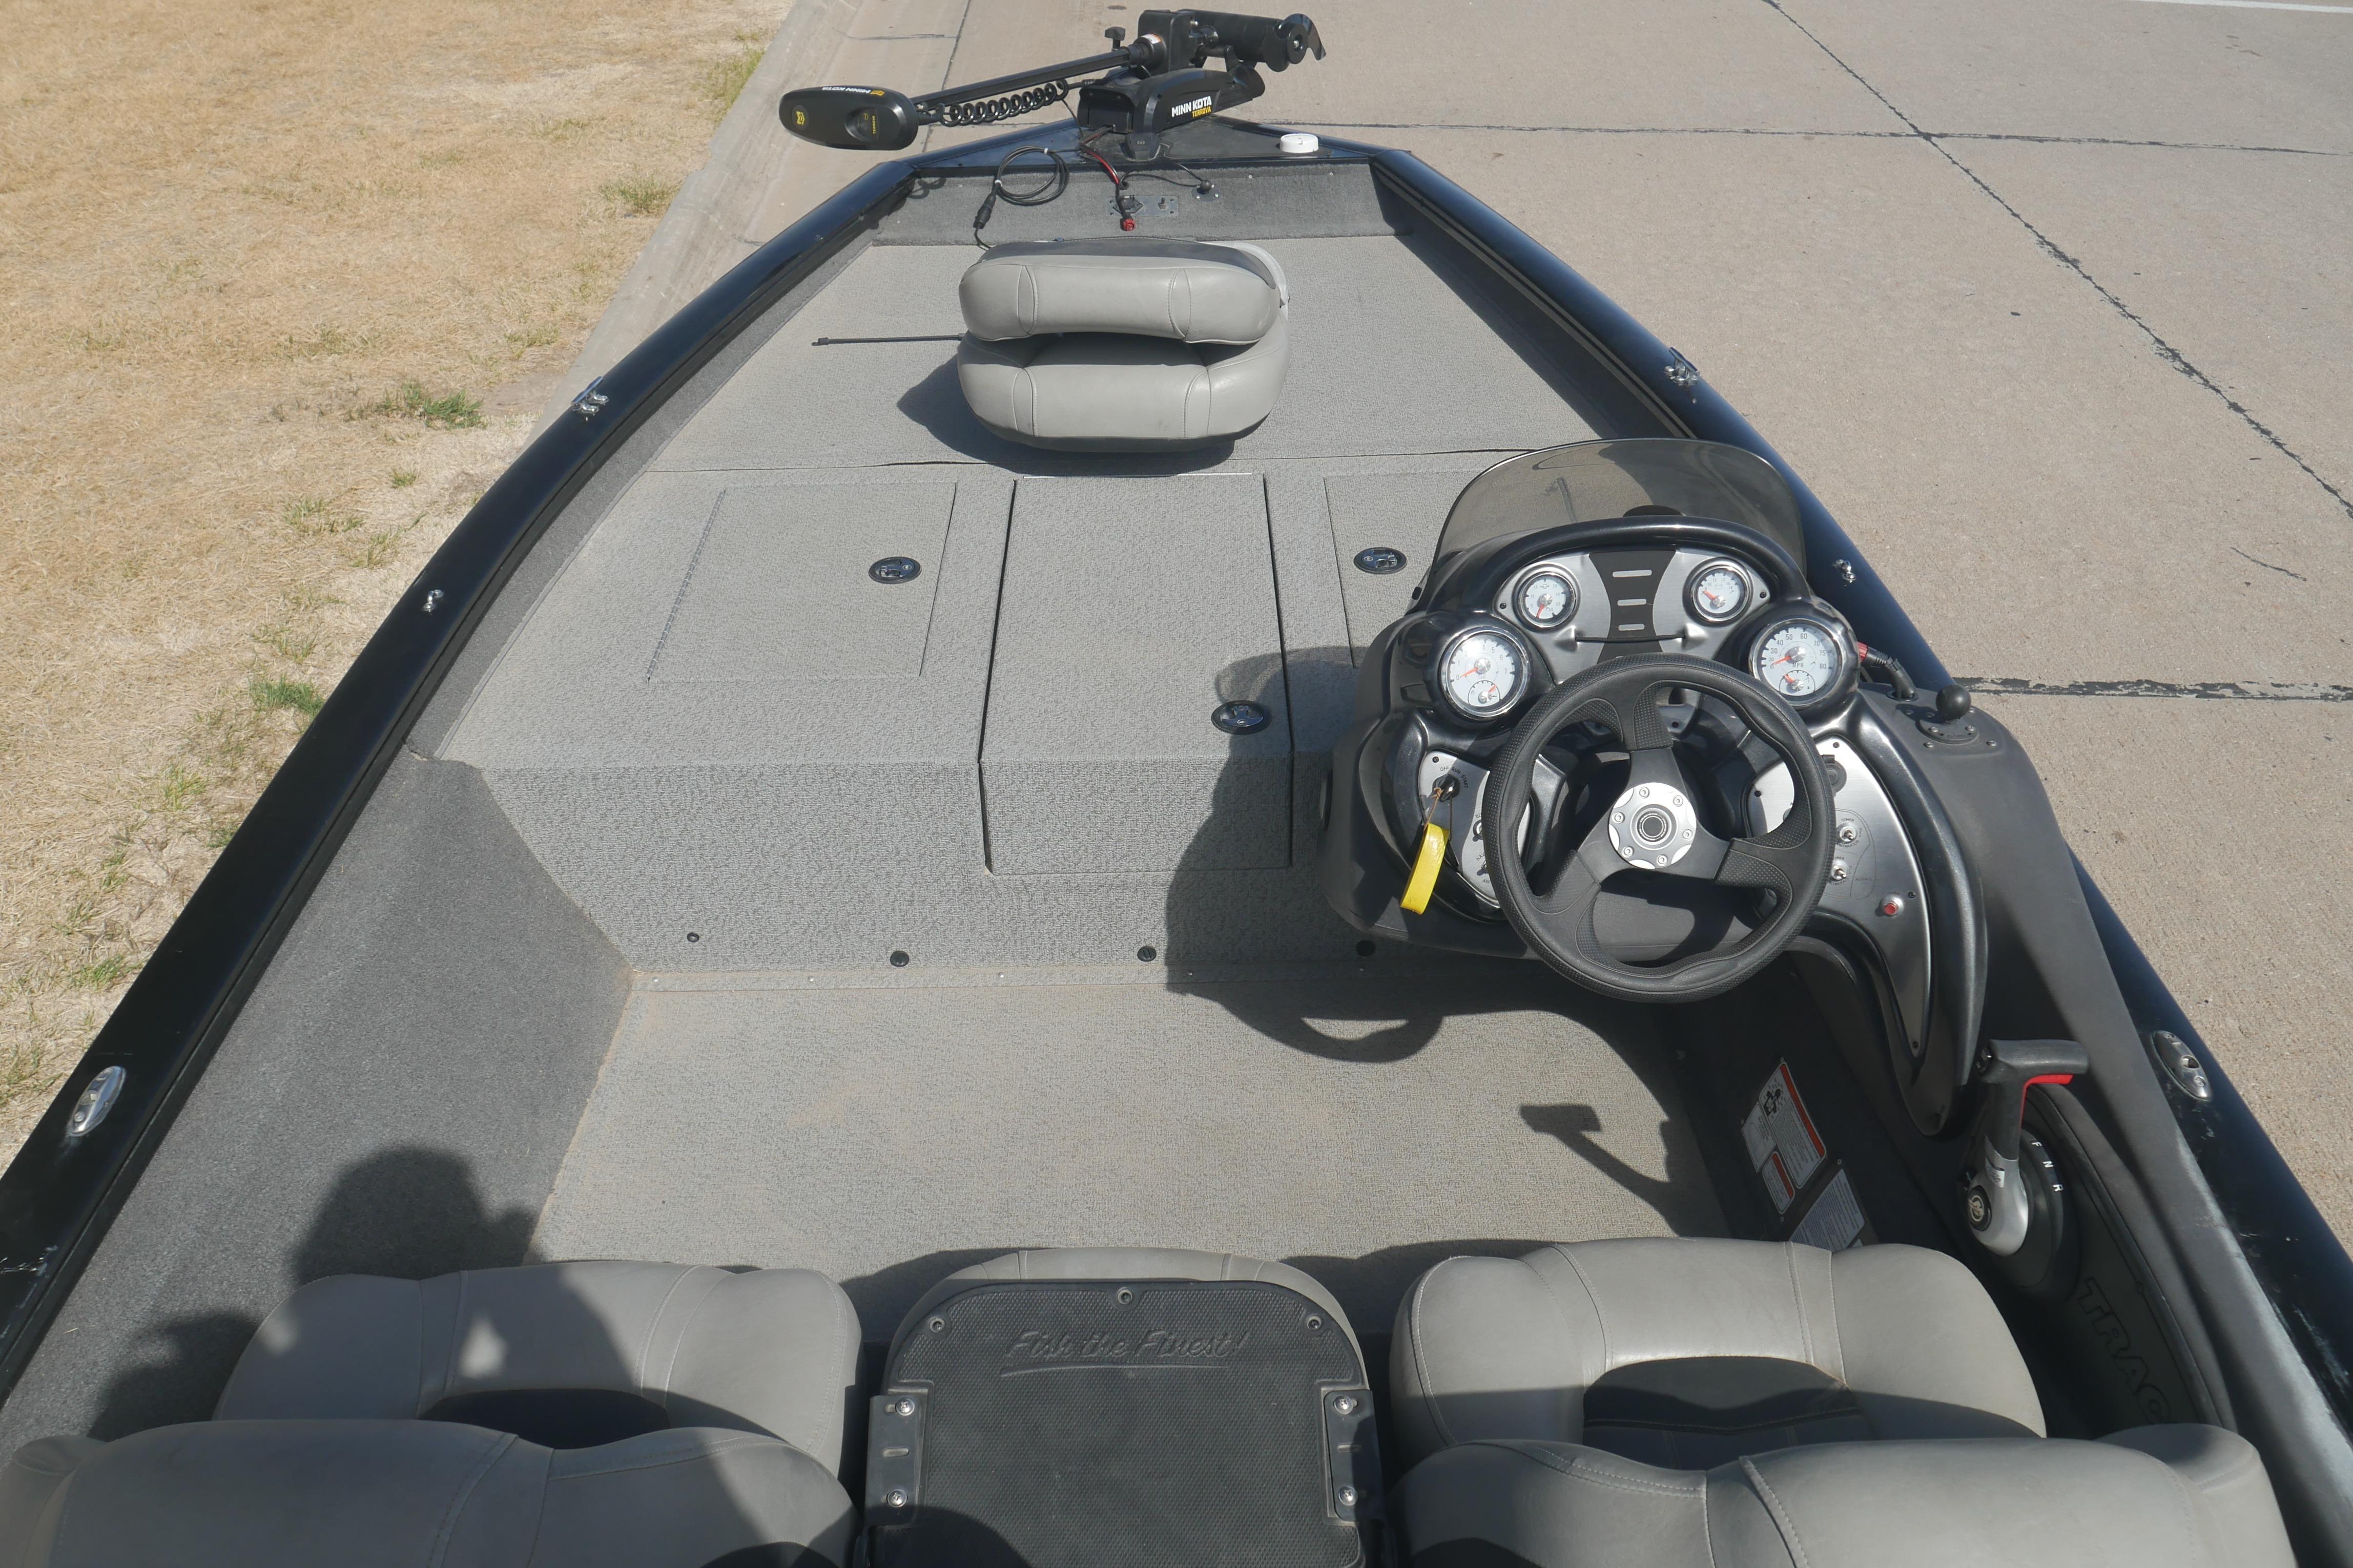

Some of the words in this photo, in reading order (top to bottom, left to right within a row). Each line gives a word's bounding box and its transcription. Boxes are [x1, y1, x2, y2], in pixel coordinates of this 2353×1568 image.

[1171, 102, 1192, 117] MINN
[1192, 96, 1212, 110] KOTA
[1192, 106, 1211, 117] TERROVA
[1460, 774, 1469, 788] START
[2053, 1184, 2063, 1192] R
[1005, 1329, 1075, 1357] Fish
[1079, 1332, 1127, 1357] the
